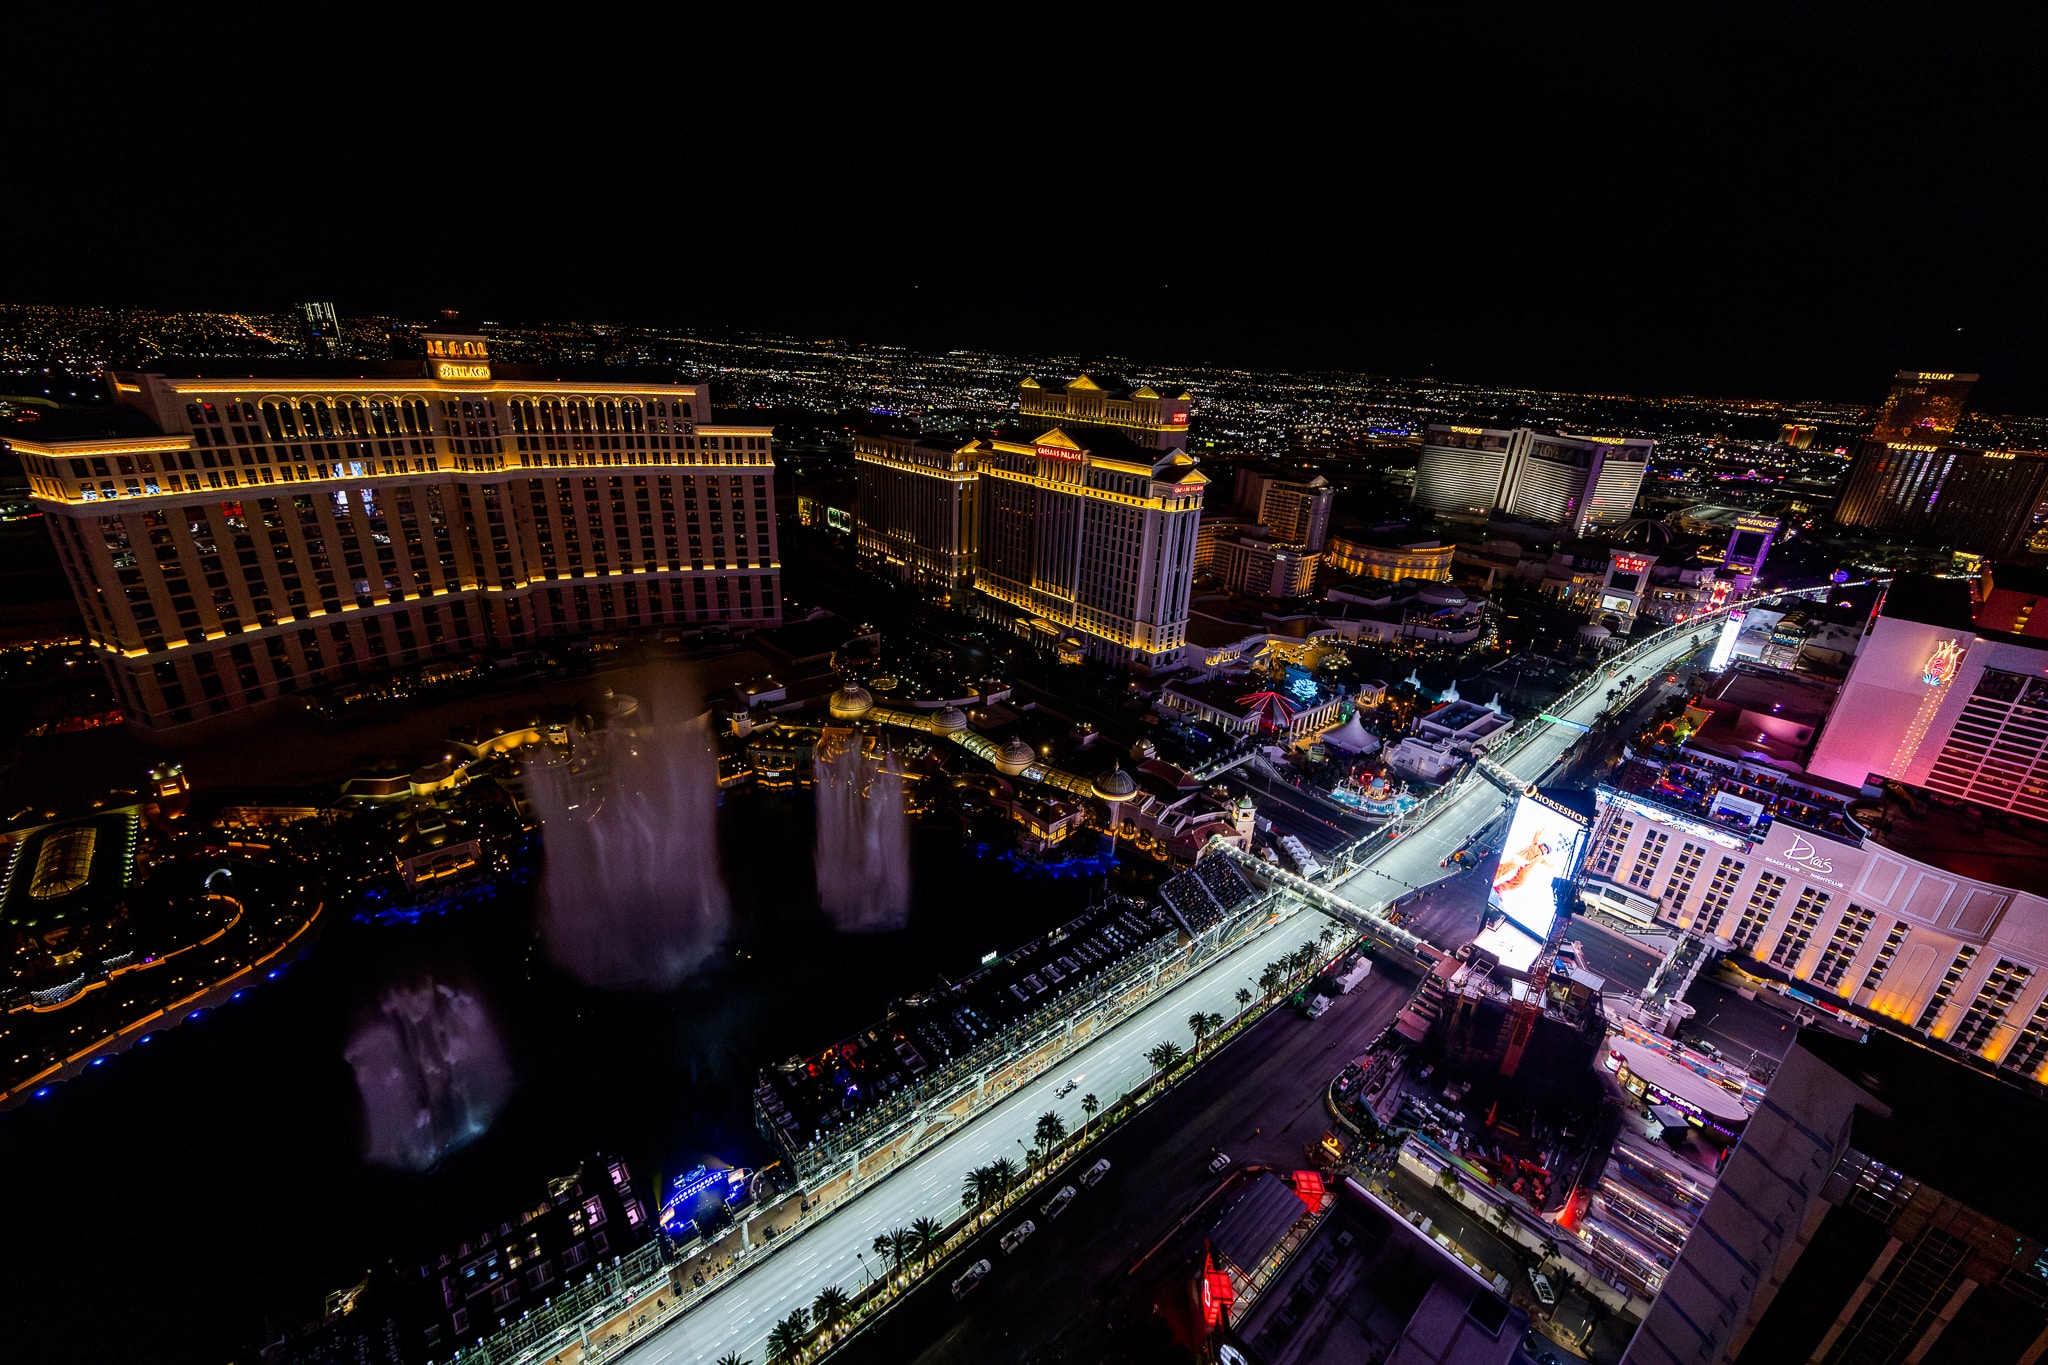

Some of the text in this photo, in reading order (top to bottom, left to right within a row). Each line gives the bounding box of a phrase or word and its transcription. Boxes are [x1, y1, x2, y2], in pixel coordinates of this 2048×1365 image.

[1918, 372, 1955, 380] TRUMP
[1458, 426, 1483, 435] MIRAGE
[1599, 437, 1626, 445] MIRAGE
[1887, 442, 1938, 452] TREASURE
[1037, 447, 1082, 461] CAESARS PALACE
[1983, 451, 2016, 460] ISLAND
[1745, 518, 1779, 528] MIRAGE
[1616, 556, 1647, 566] CAESARS
[1534, 792, 1589, 826] HORSESHOE
[1765, 857, 1844, 888] BEACH CLUB NIGHTCLUB
[981, 950, 997, 964] MGM
[1671, 1100, 1695, 1116] KNOW
[1695, 1113, 1711, 1125] YOU
[1713, 1122, 1736, 1138] WANT
